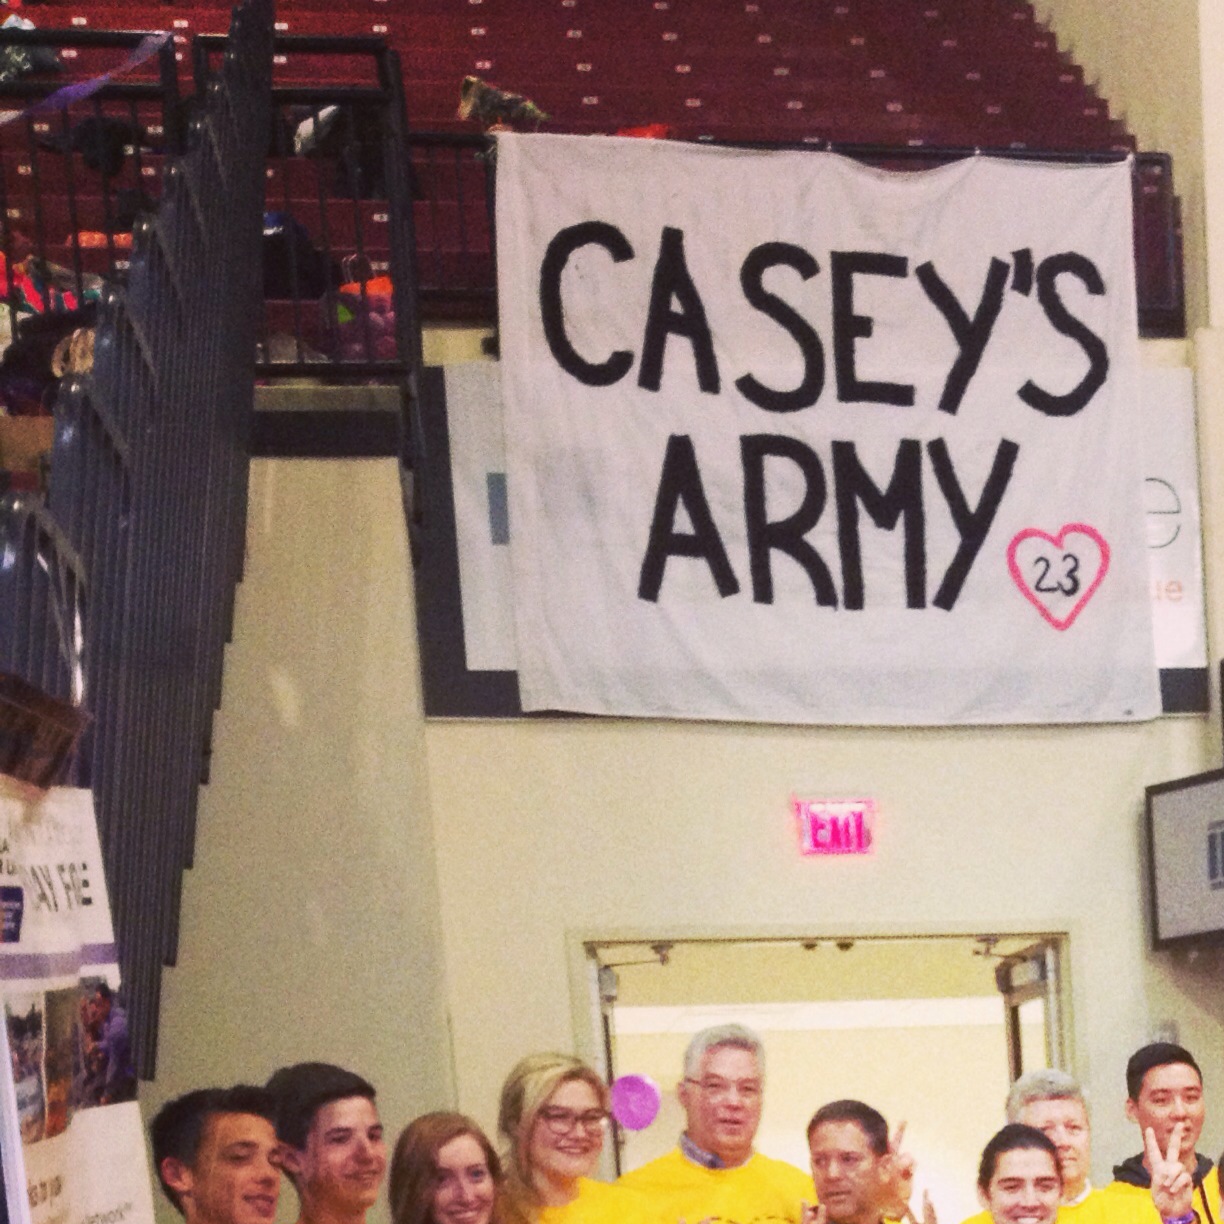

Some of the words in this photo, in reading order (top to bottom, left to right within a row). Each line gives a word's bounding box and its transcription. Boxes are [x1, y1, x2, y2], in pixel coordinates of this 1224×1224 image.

[539, 220, 1110, 417] CASEY'S
[637, 433, 1020, 612] ARMY
[1033, 555, 1082, 598] 23
